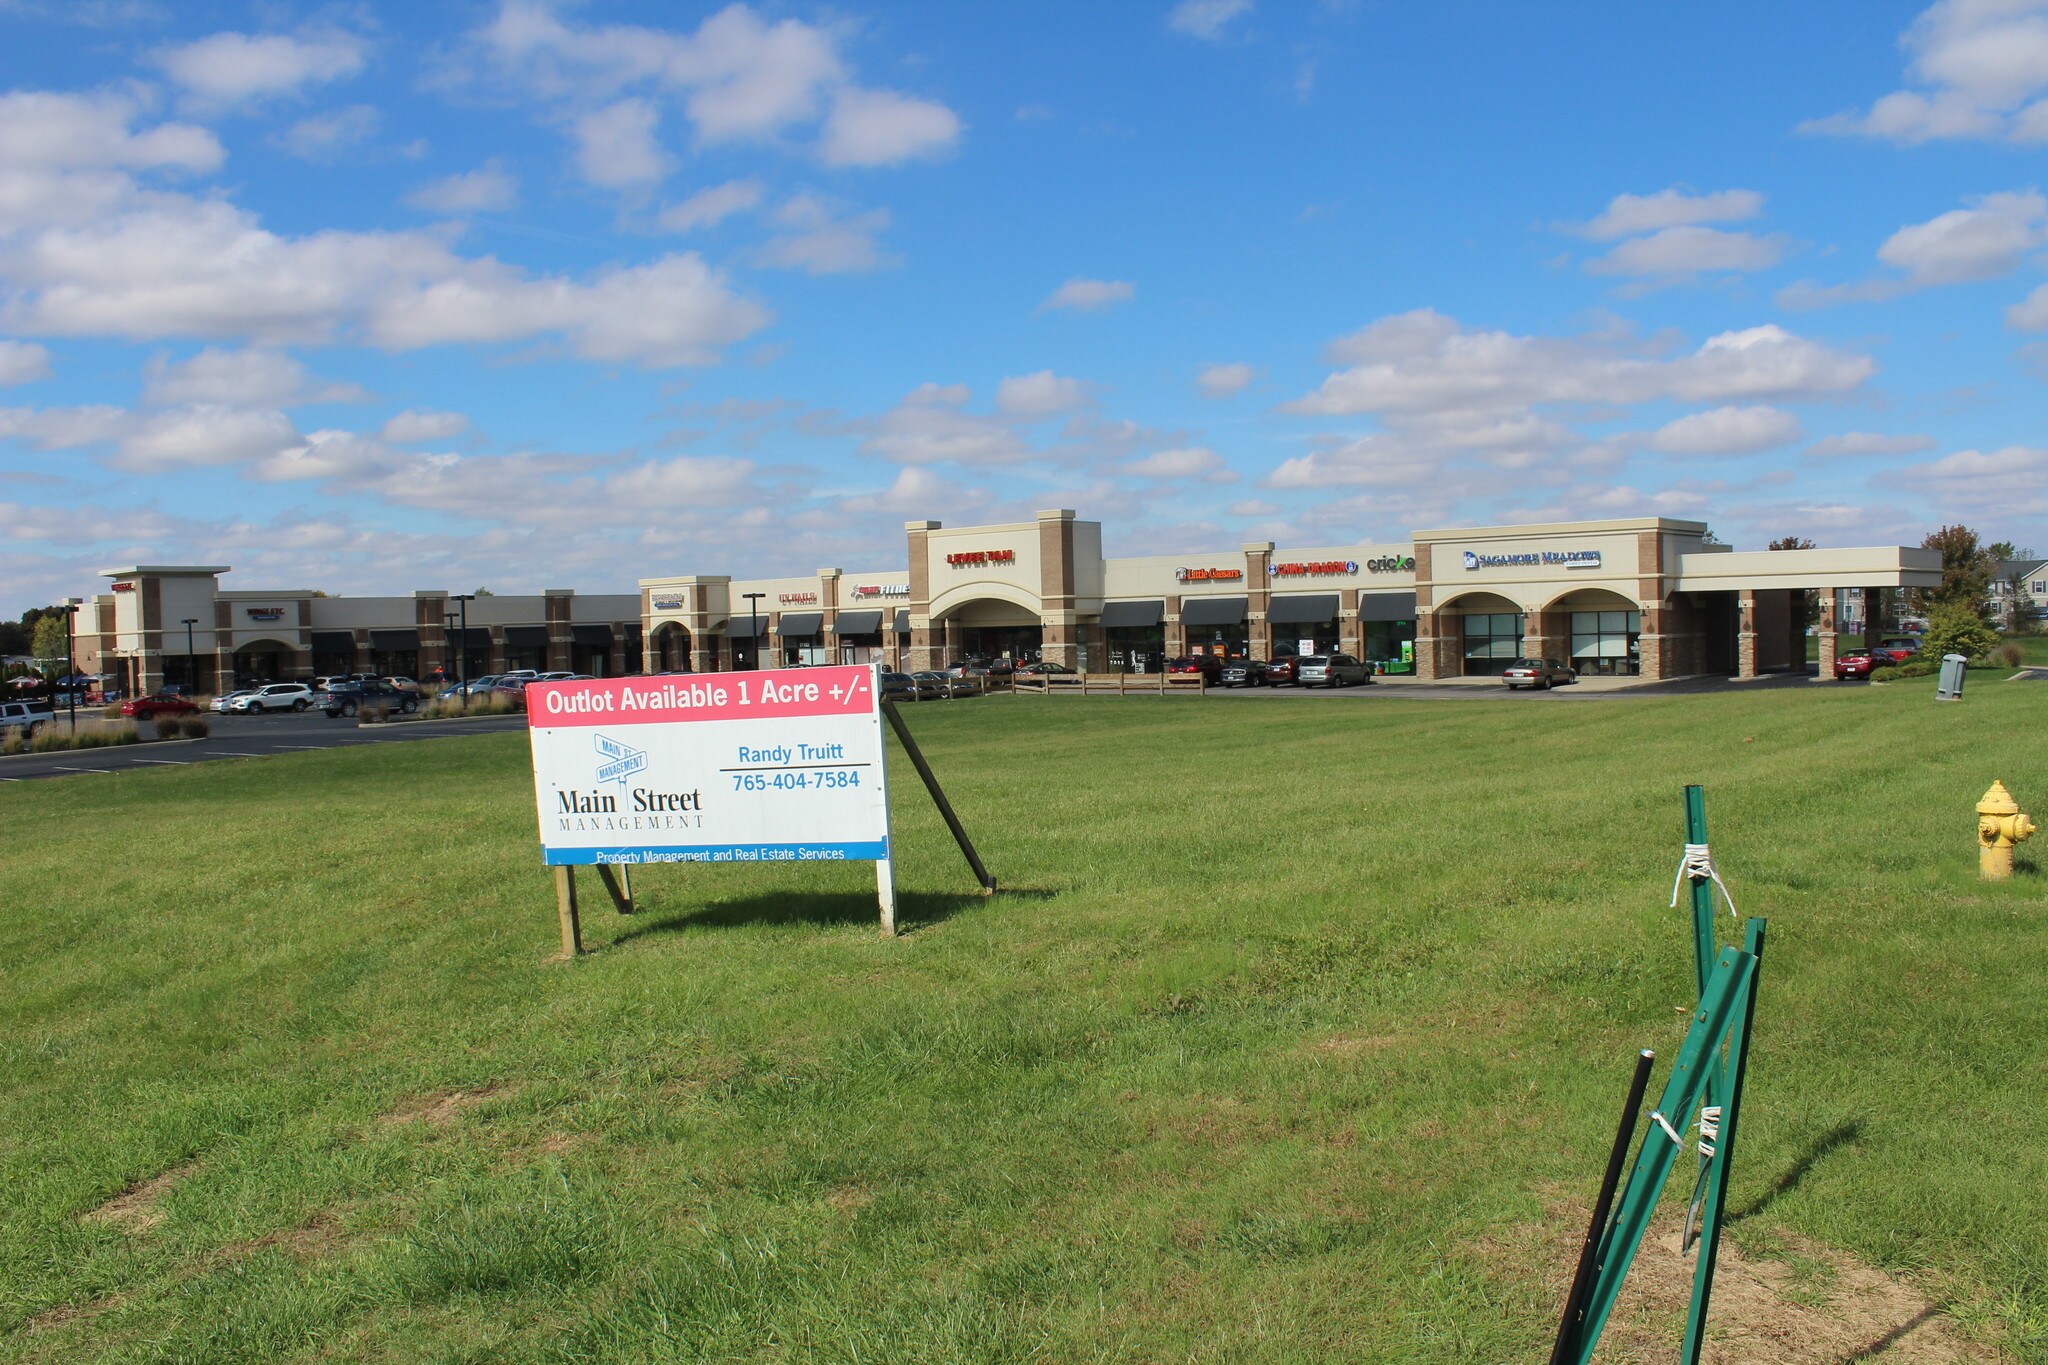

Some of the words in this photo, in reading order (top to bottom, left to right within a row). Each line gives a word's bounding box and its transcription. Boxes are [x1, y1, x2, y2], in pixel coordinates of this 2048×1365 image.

[1366, 554, 1416, 570] cricke
[1479, 553, 1539, 563] SAGAMORE
[1541, 550, 1600, 561] MEADOWS
[1187, 568, 1209, 580] Little
[1209, 567, 1240, 579] Caesars
[1278, 562, 1305, 574] CHINA
[1307, 561, 1347, 573] DRAGON
[880, 585, 909, 594] FITNE
[546, 689, 614, 714] Outlot
[620, 683, 727, 711] Available
[737, 681, 751, 705] 1
[761, 680, 820, 704] Acre
[828, 675, 868, 705] +/-
[602, 740, 621, 756] MAIN
[739, 745, 792, 764] Randy
[797, 743, 844, 760] Truitt
[599, 755, 643, 779] MANAGEMENT
[733, 771, 860, 791] 765-404-7584
[557, 789, 617, 814] Main
[633, 788, 703, 812] Street
[559, 815, 704, 831] MANAGEMENT
[596, 851, 640, 863] Property
[643, 850, 710, 862] Management
[713, 849, 732, 861] and
[735, 848, 759, 860] Real
[761, 848, 795, 860] Estate
[798, 847, 845, 860] Services
